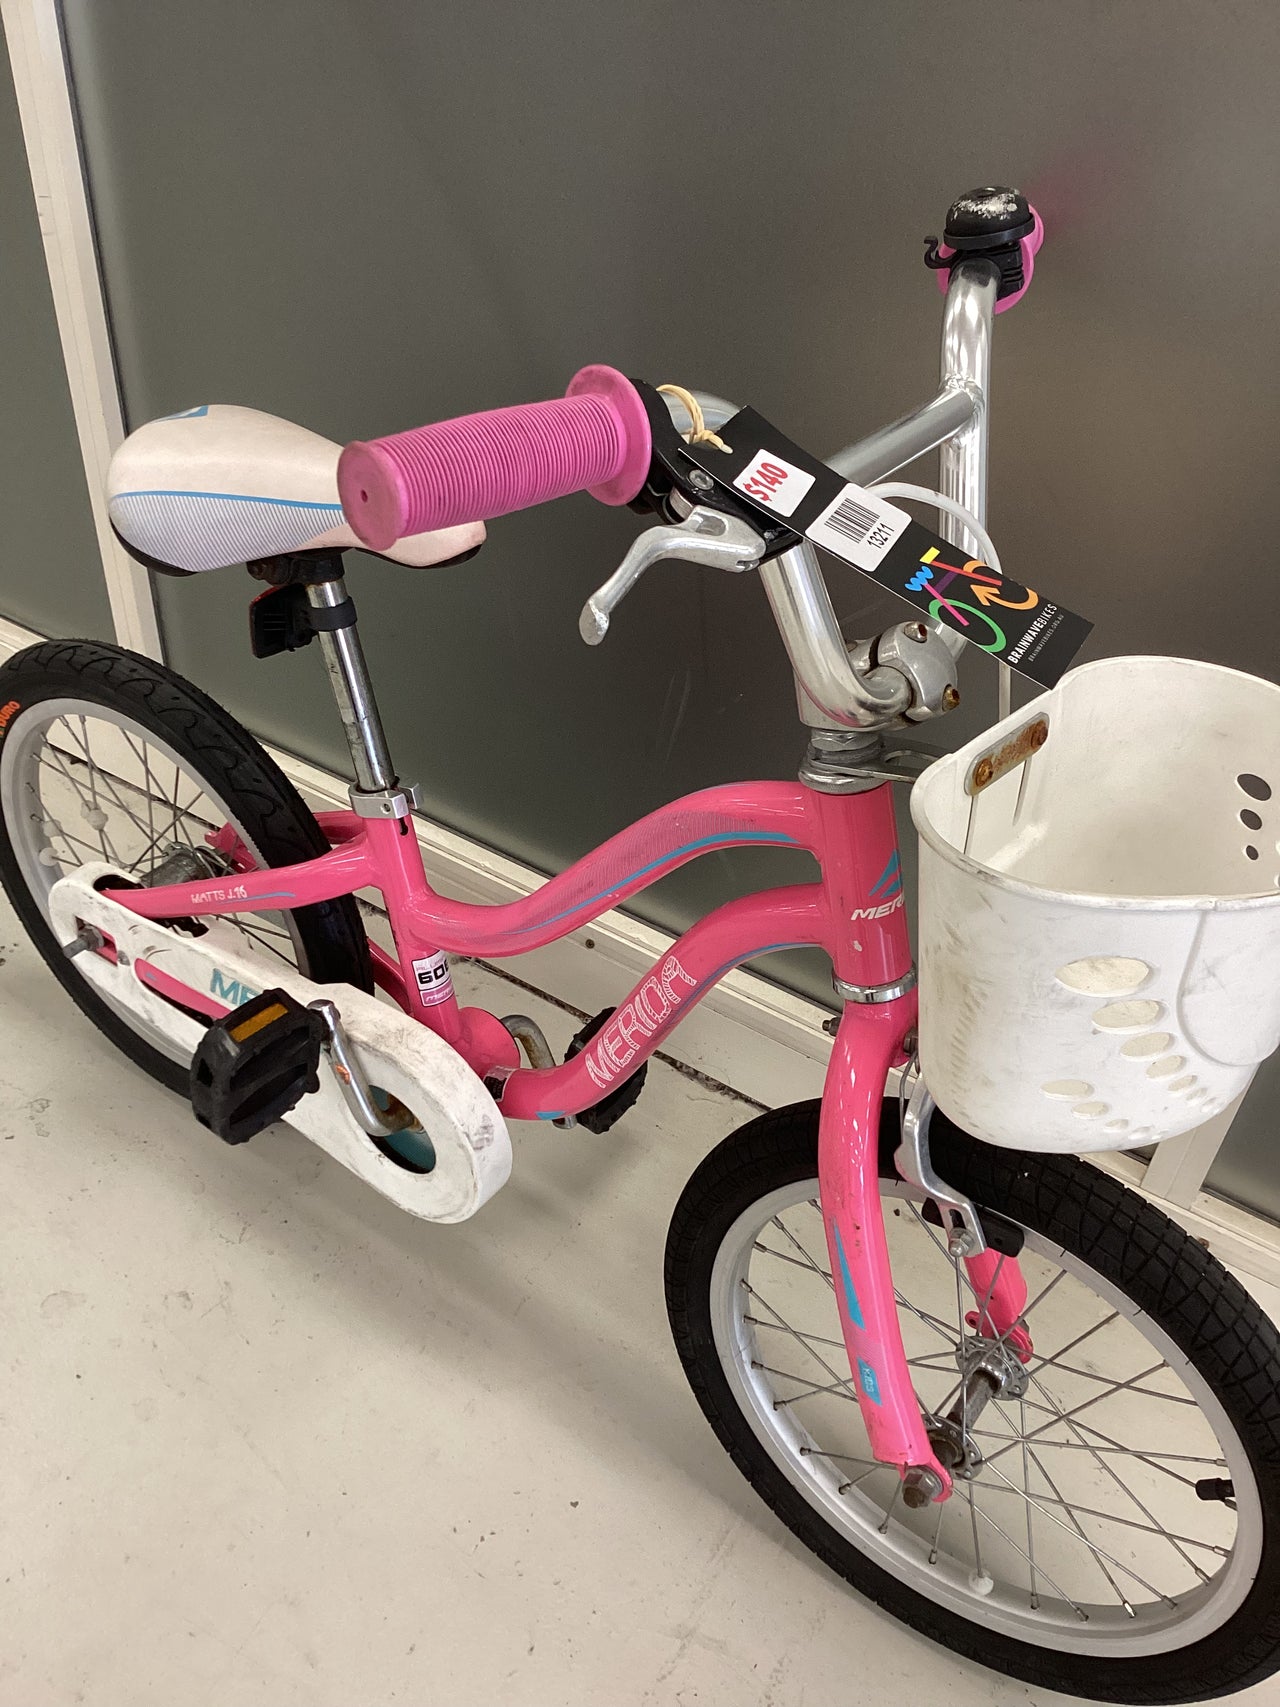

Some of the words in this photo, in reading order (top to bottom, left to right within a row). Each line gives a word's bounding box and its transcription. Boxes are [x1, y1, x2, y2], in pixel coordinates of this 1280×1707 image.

[743, 462, 788, 502] $140
[866, 522, 895, 549] 13211
[1007, 603, 1058, 664] BRAINWAVEBIKES
[191, 890, 225, 904] MATTS
[227, 885, 248, 899] J.16
[585, 955, 698, 1089] MERIDA
